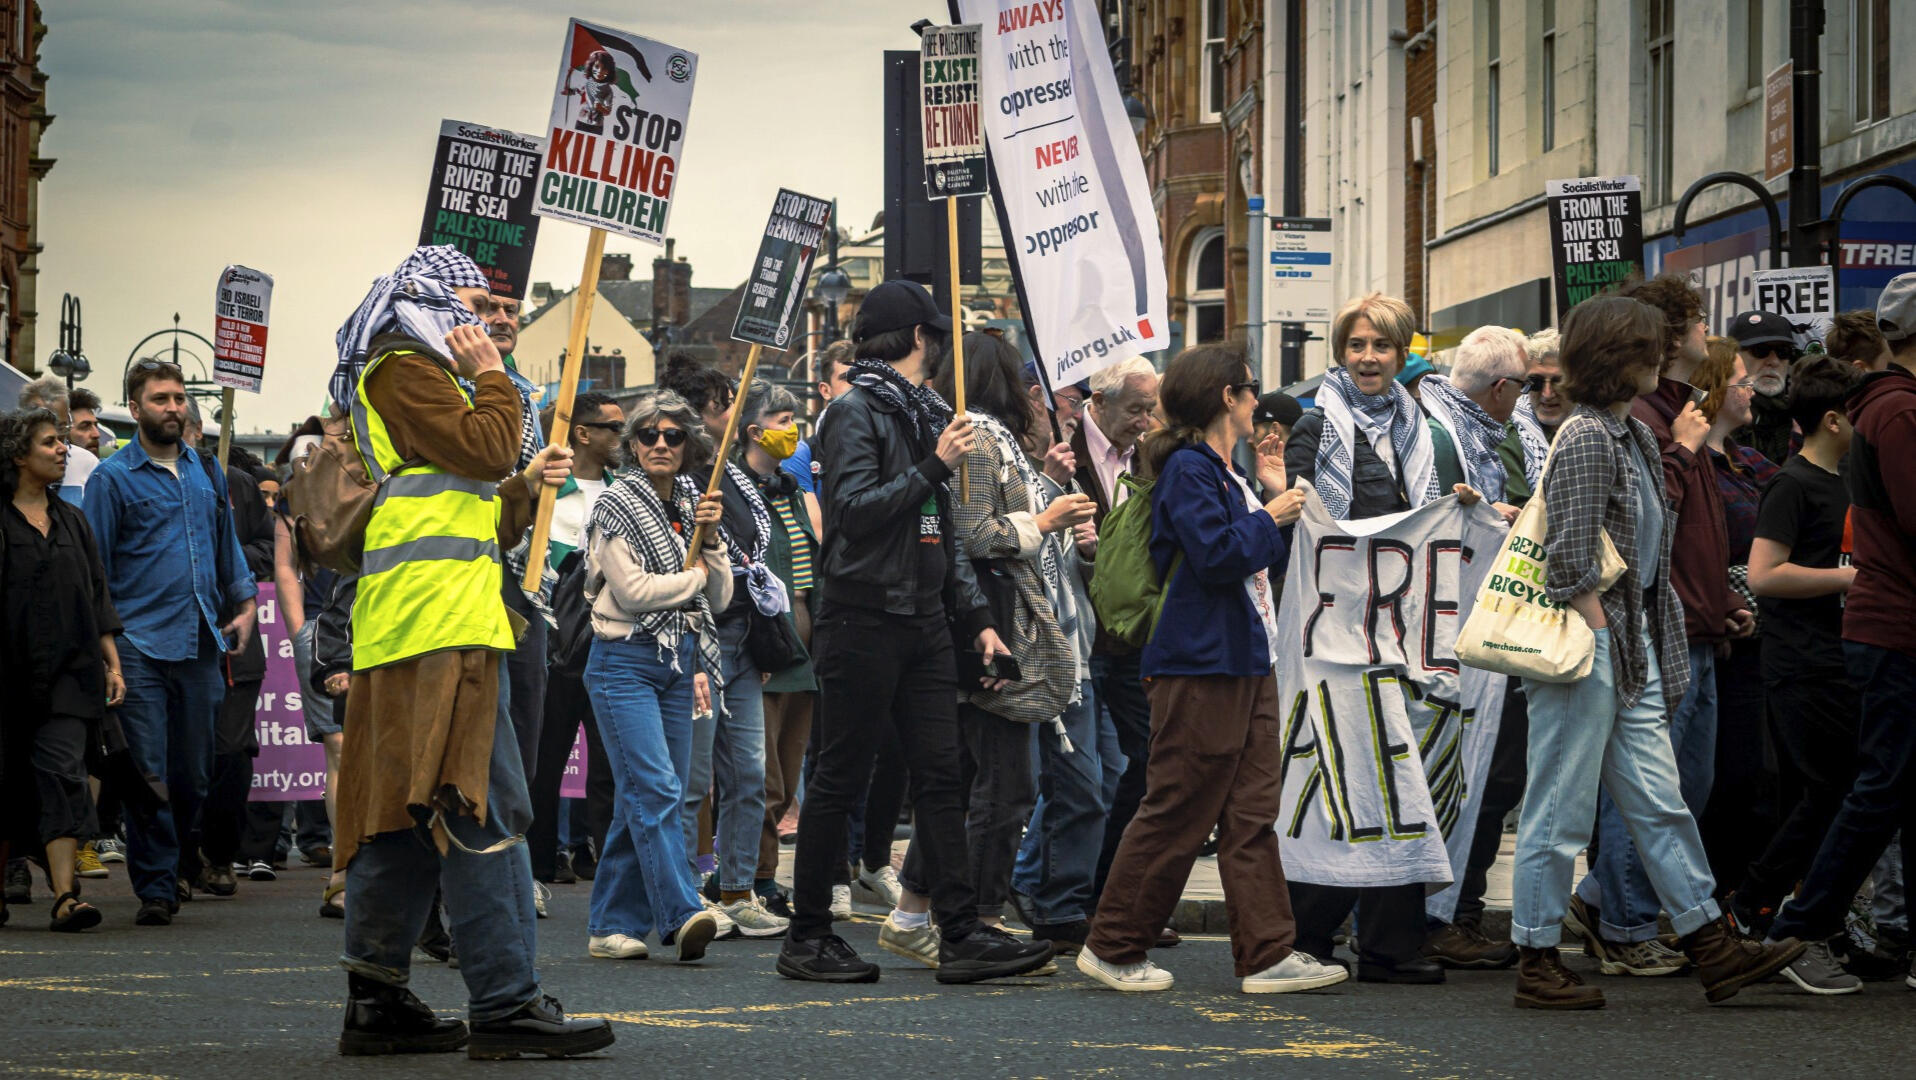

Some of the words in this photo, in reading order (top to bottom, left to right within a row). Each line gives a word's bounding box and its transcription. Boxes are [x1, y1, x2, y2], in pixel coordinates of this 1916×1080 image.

[997, 0, 1064, 35] ALWAYS
[939, 31, 977, 56] PALESTINE
[1007, 39, 1046, 71] with
[1048, 34, 1068, 60] the
[924, 58, 977, 84] EXIST!
[924, 83, 978, 105] RESIST!
[613, 104, 682, 153] STOP
[925, 103, 980, 149] RETURN!
[448, 141, 498, 170] FROM
[503, 151, 536, 178] THE
[546, 128, 675, 200] KILLING
[1034, 135, 1079, 170] NEVER
[443, 164, 494, 193] RIVER
[500, 174, 521, 199] TO
[1035, 175, 1072, 208] with
[441, 186, 474, 213] THE
[476, 194, 508, 220] SEA
[540, 171, 668, 234] CHILDREN
[553, 209, 577, 219] Palestine
[775, 191, 807, 220] STOP
[804, 199, 829, 225] THE
[1560, 196, 1602, 219] FROM
[1604, 195, 1629, 216] THE
[435, 209, 526, 247] PALESTINE
[766, 215, 823, 249] GENOCIDE
[1562, 219, 1605, 241] RIVER
[1606, 218, 1623, 238] TO
[475, 240, 499, 266] BE
[1563, 241, 1594, 263] THE
[1597, 240, 1620, 261] SEA
[1840, 243, 1916, 266] TFRE
[1565, 260, 1635, 285] PALESTINE
[234, 291, 261, 308] ISRAELI
[238, 304, 263, 323] TERROR
[1758, 281, 1830, 315] FREE
[1508, 535, 1547, 563] RED
[1302, 536, 1473, 673] FRE
[1482, 640, 1542, 654] paperchase.com
[251, 768, 327, 792] arty.or
